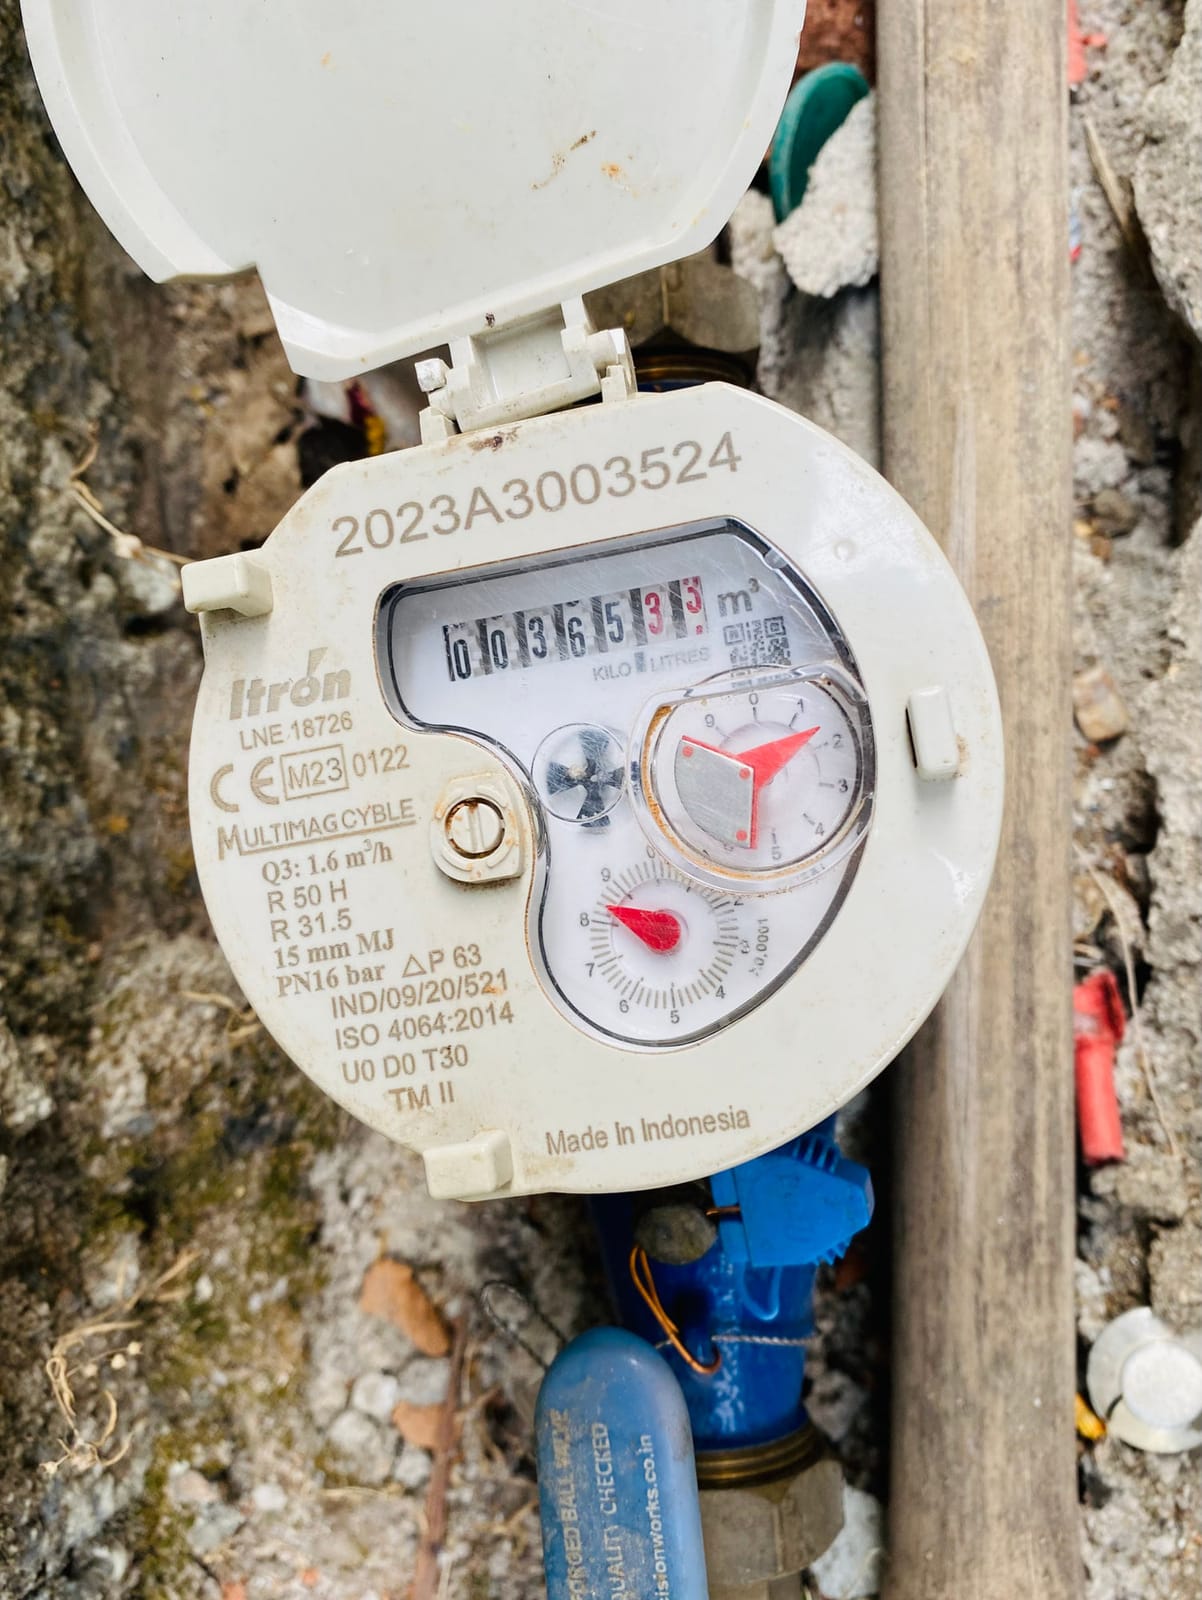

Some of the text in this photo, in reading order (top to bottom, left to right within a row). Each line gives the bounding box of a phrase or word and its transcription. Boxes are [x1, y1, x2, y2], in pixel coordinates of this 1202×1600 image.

[330, 430, 743, 558] 2023A3003524
[592, 647, 710, 681] KILO LITRES
[239, 710, 353, 751] LNE 18726
[287, 757, 344, 791] M23
[352, 745, 411, 778] 0122
[837, 779, 849, 793] 3
[814, 822, 825, 837] 4
[261, 858, 301, 887] Q3:
[307, 850, 339, 876] 1.6
[771, 846, 782, 861] 5
[600, 867, 612, 883] 9
[267, 878, 348, 914] R 50 H
[270, 907, 353, 943] R 31.5
[579, 912, 590, 927] 8
[274, 927, 396, 970] 15 mm MJ
[276, 966, 340, 998] PN16
[344, 963, 386, 987] bar
[452, 943, 483, 969] 63
[585, 962, 596, 978] 7
[330, 968, 509, 1019] IND/09/20/521
[618, 999, 630, 1014] 6
[715, 984, 726, 1000] 4
[335, 1001, 515, 1051] ISO 4064:2014
[669, 1010, 681, 1025] 5
[422, 1044, 470, 1072] T30
[387, 1086, 432, 1112] TM
[545, 1131, 609, 1156] Made
[640, 1104, 751, 1143] Indonesia
[591, 1422, 618, 1515] CHECKED
[638, 1434, 671, 1600] isionworks.co.in
